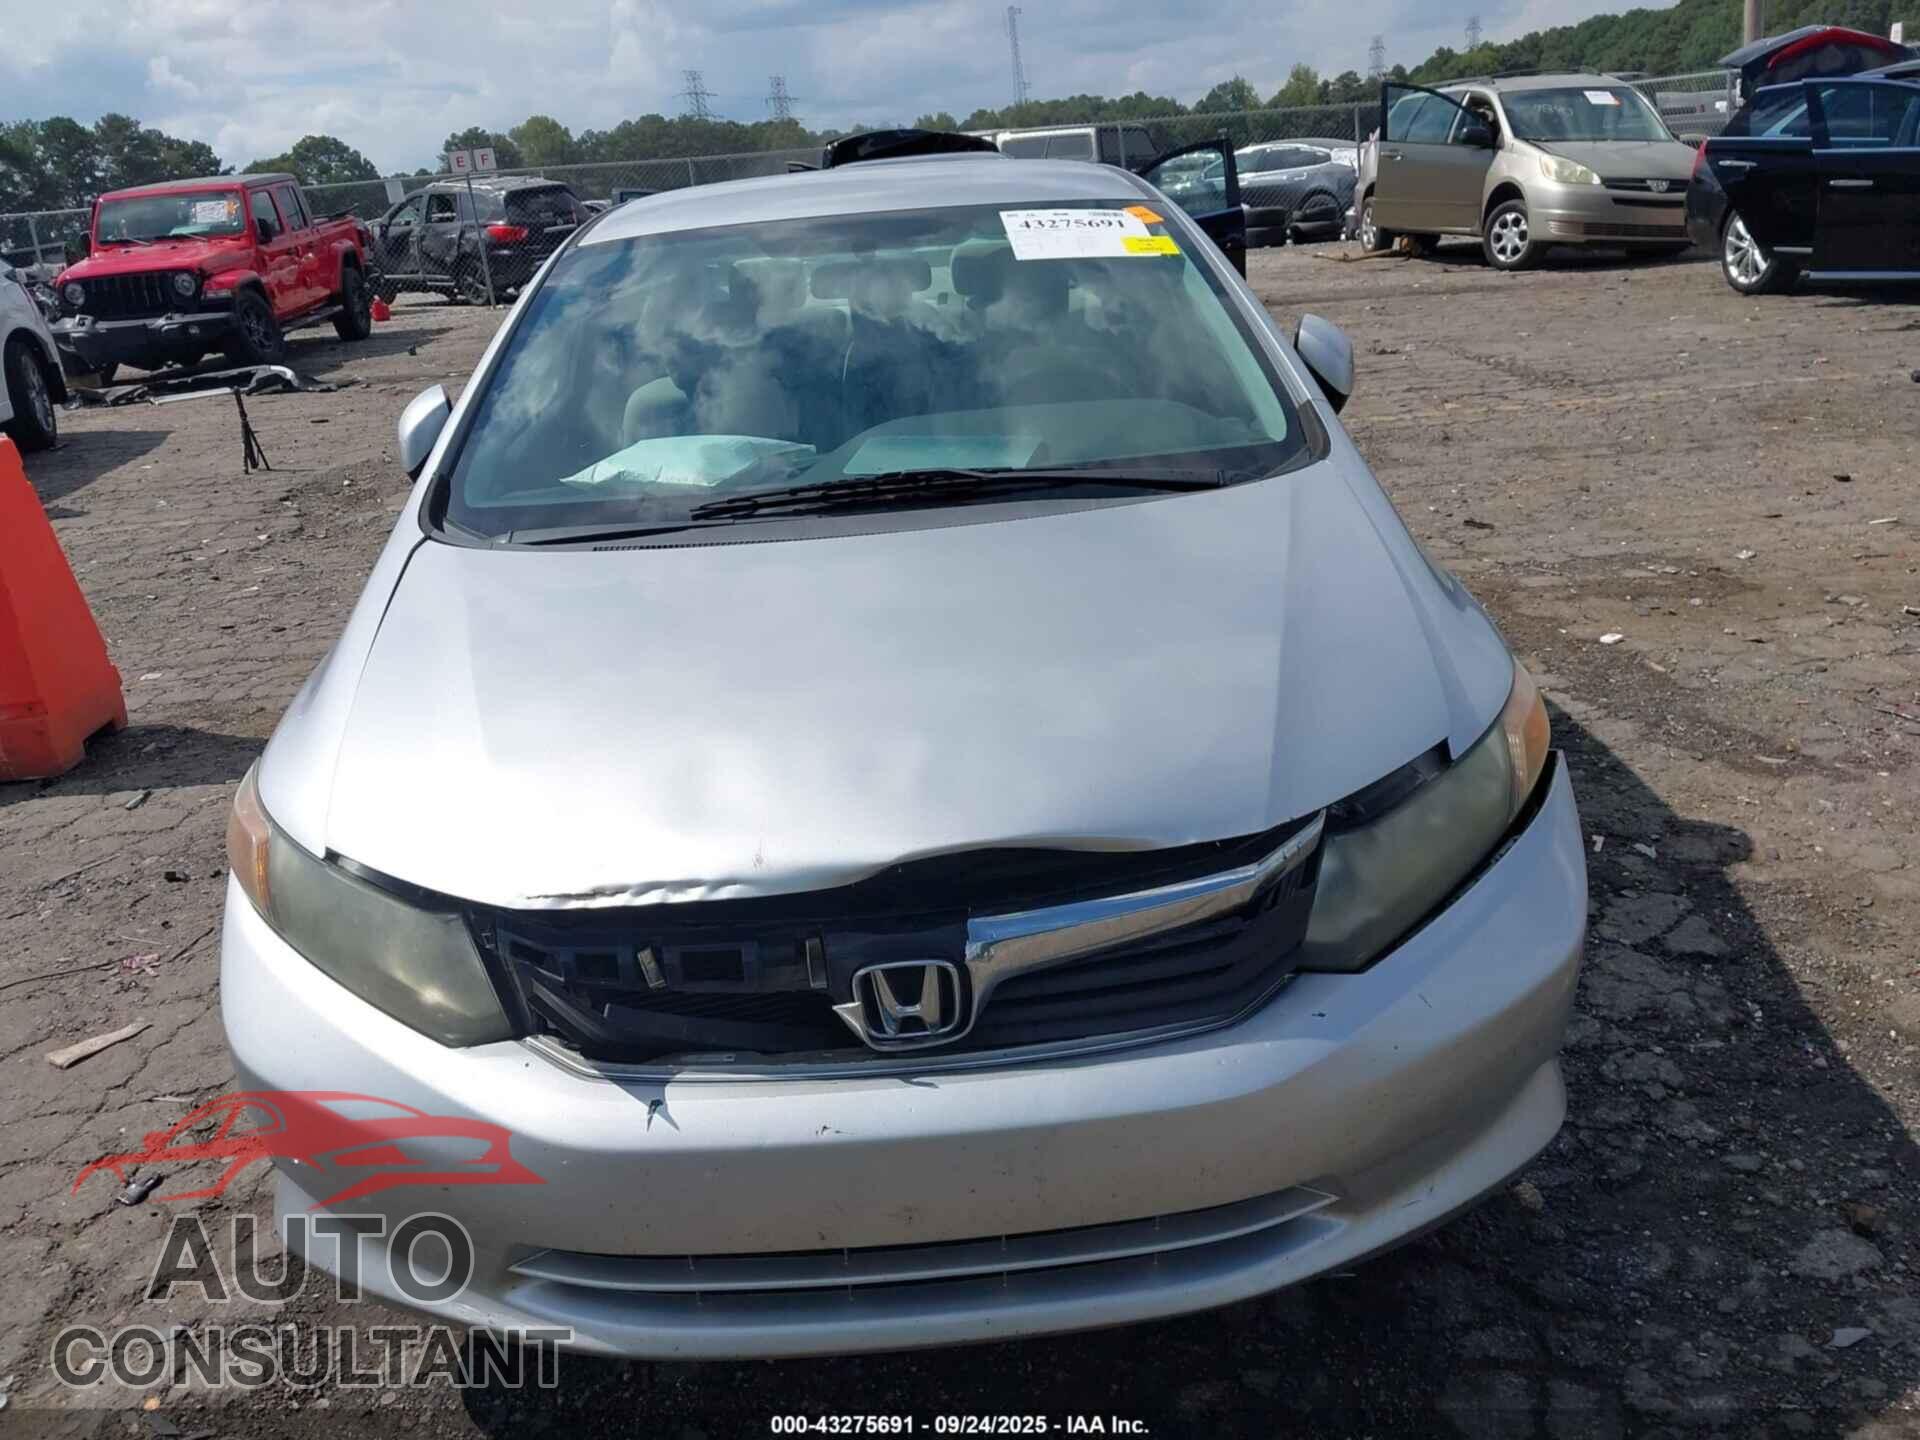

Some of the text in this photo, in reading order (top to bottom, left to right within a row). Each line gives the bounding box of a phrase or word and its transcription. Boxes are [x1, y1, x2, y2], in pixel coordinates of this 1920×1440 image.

[456, 156, 465, 168] E
[480, 153, 488, 167] F
[1019, 218, 1126, 230] 43275691
